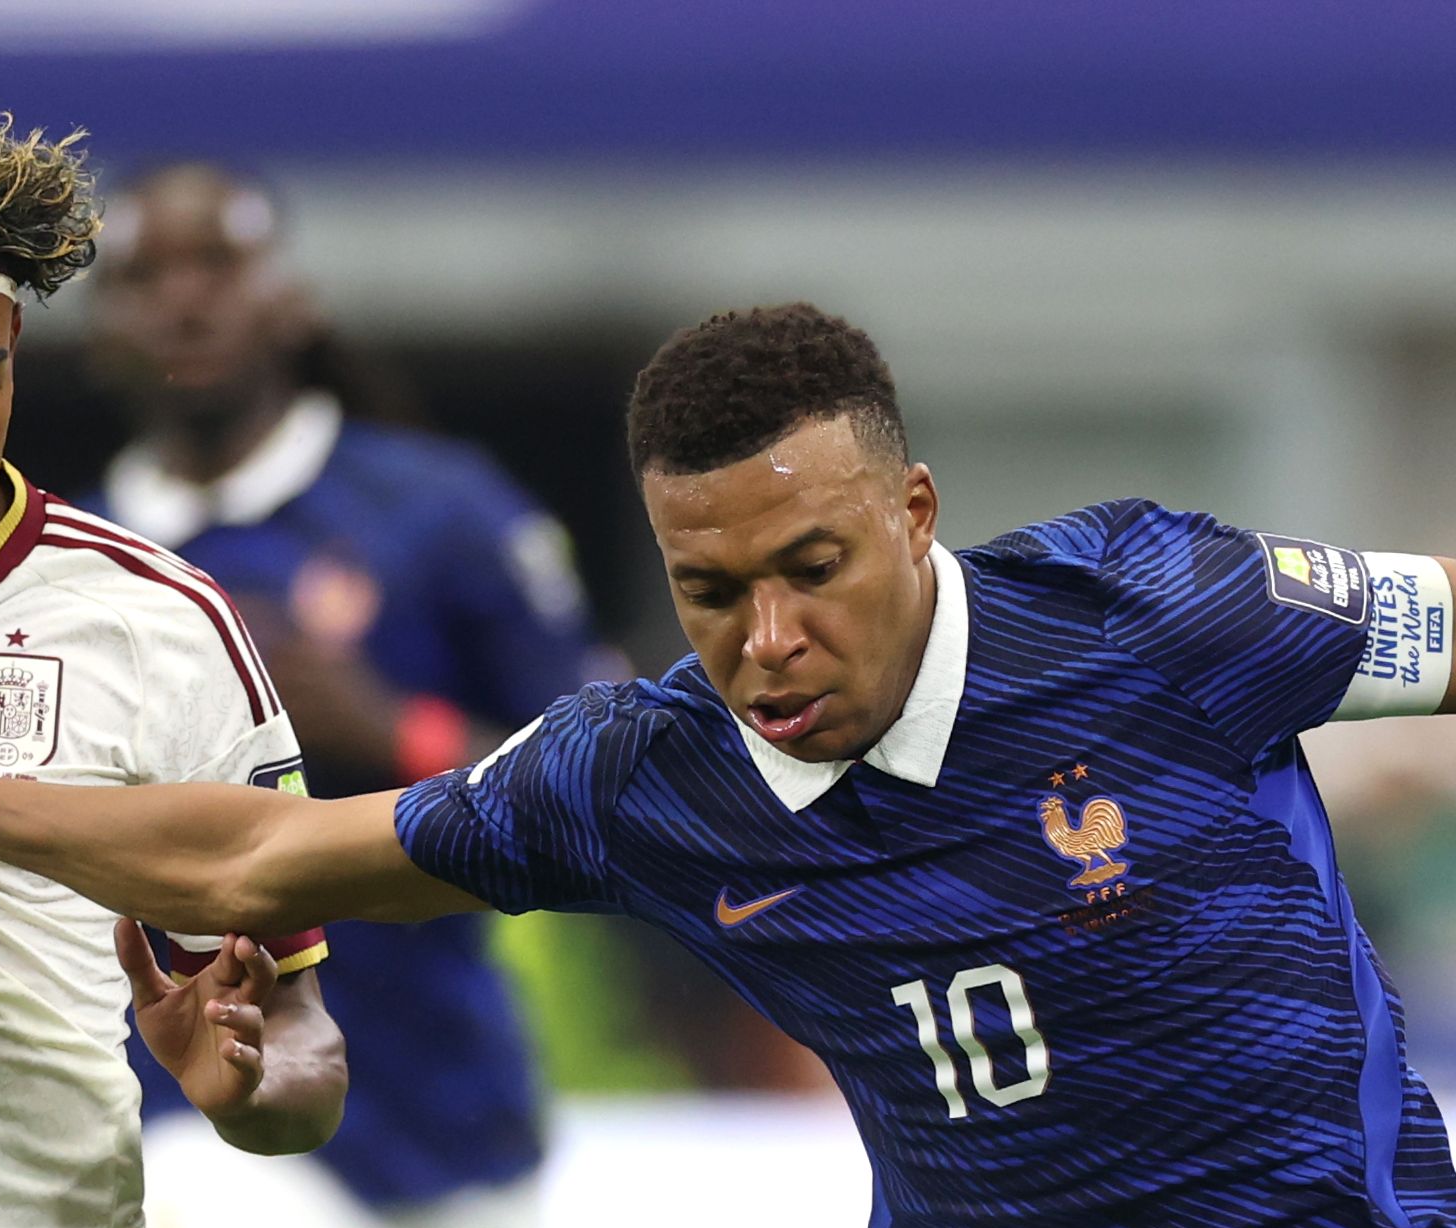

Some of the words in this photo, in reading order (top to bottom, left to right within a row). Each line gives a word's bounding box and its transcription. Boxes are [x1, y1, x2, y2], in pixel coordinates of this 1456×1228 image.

[1348, 567, 1360, 591] FIFA
[1393, 570, 1422, 642] World
[1371, 576, 1398, 680] UNITES
[1428, 609, 1442, 650] FIFA
[1399, 645, 1420, 688] the
[890, 963, 1053, 1119] 10
